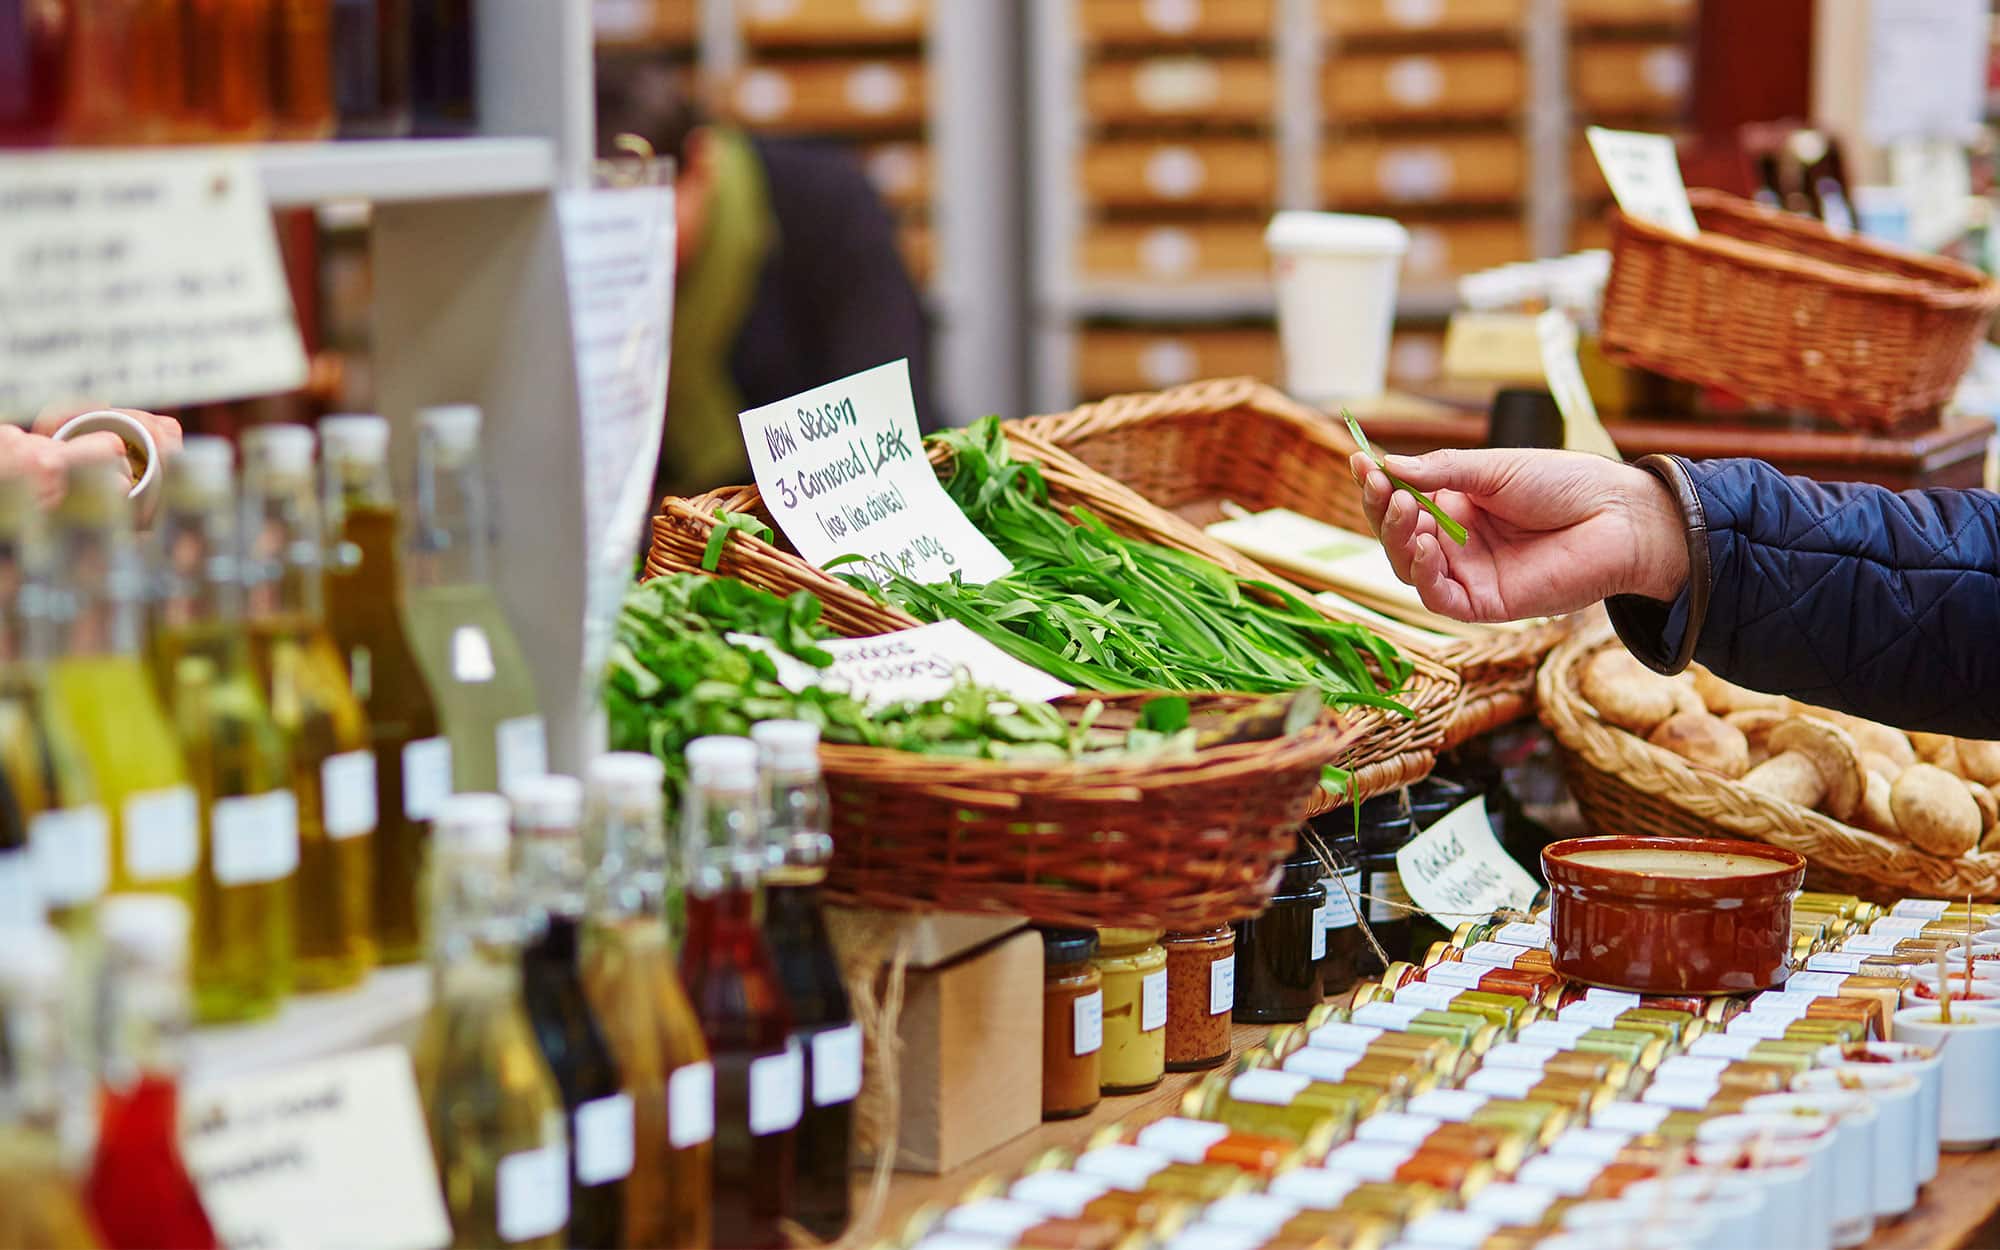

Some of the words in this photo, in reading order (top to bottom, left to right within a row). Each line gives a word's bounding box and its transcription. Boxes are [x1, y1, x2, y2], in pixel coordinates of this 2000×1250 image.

[797, 397, 857, 442] Season
[860, 418, 912, 478] Leek
[841, 504, 870, 533] like
[910, 534, 956, 566] 100g
